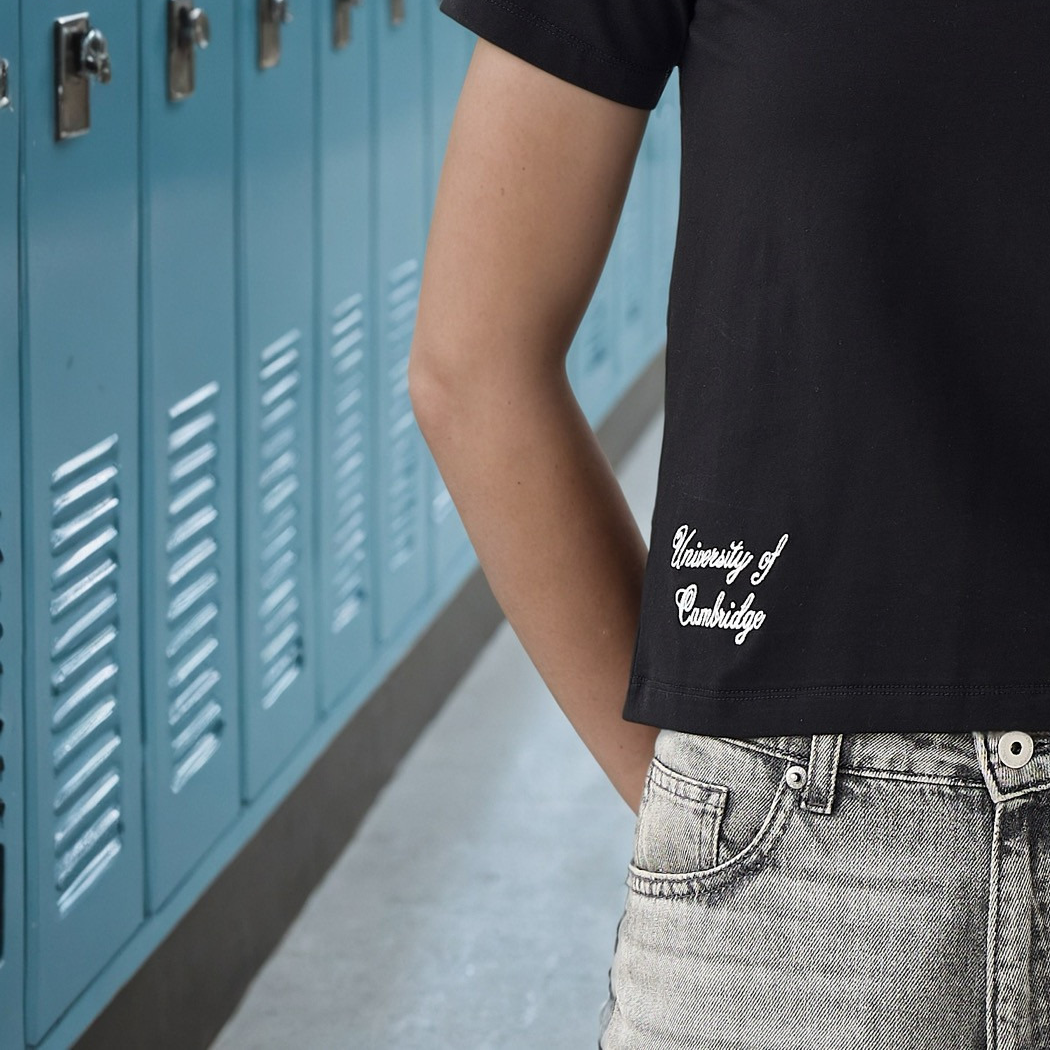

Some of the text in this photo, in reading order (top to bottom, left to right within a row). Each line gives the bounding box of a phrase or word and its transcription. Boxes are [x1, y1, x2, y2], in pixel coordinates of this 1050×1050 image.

[671, 525, 788, 585] University of
[675, 584, 766, 645] Cambridge
